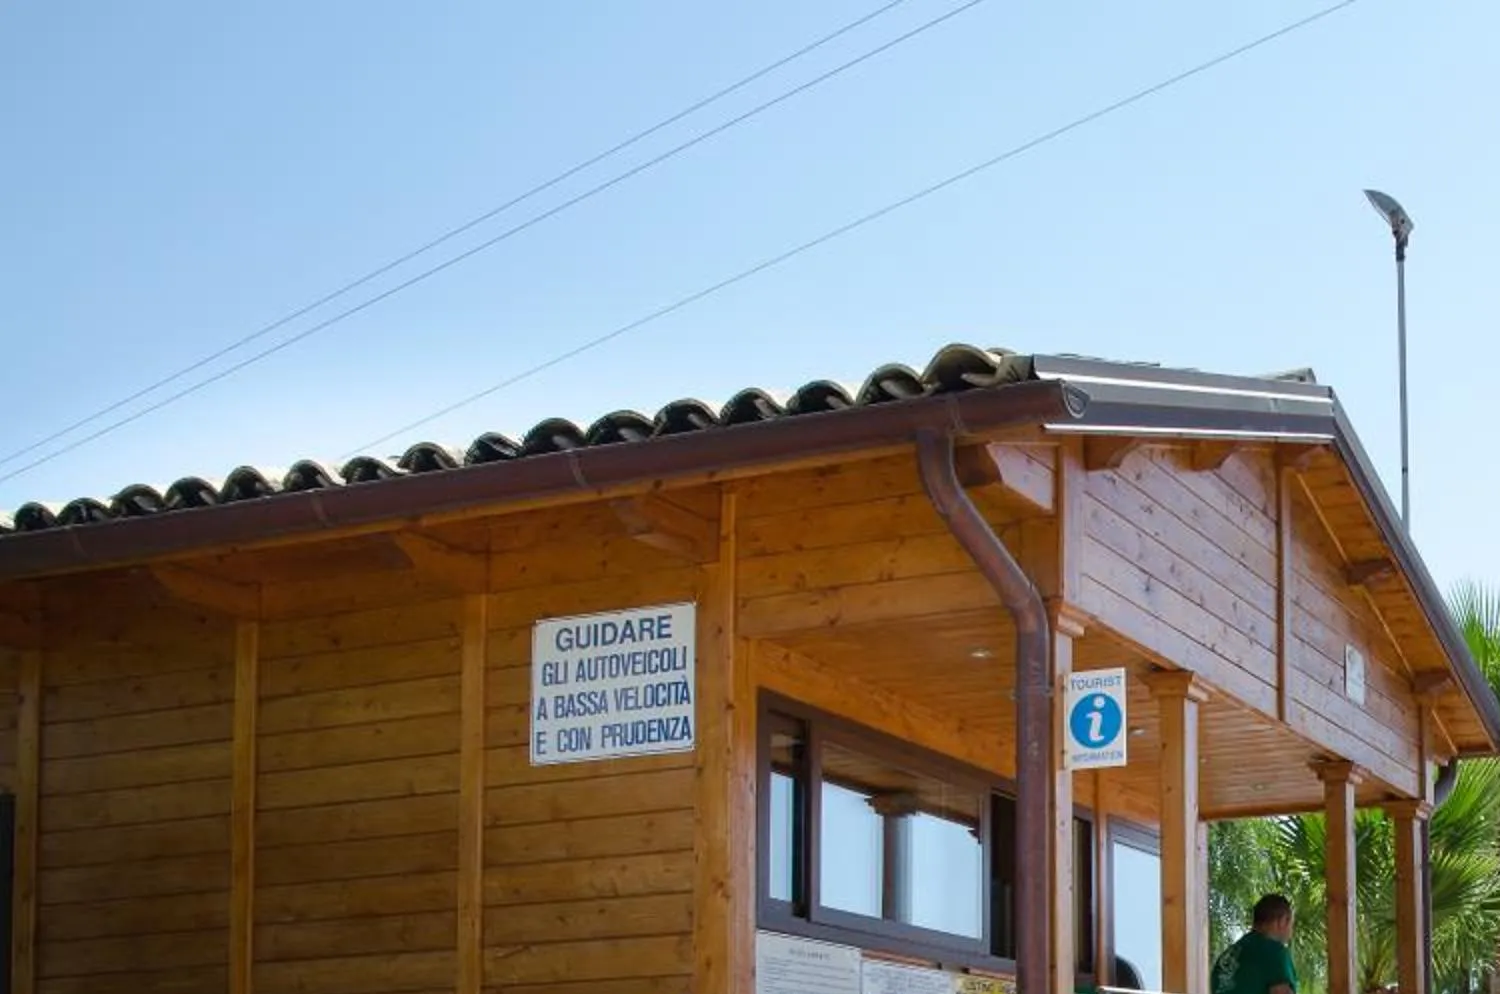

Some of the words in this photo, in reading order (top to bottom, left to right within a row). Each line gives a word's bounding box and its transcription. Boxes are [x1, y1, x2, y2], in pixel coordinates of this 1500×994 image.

[556, 615, 672, 651] GUIDARE
[543, 662, 567, 686] GLI
[576, 646, 686, 682] AUTOVEICOLI
[1071, 676, 1121, 690] TOURIST
[537, 699, 548, 720] A
[554, 691, 608, 719] BASSA
[615, 676, 691, 712] VELOCITÀ
[536, 732, 546, 754] E
[557, 727, 591, 752] CON
[601, 717, 691, 747] PRUDENZA
